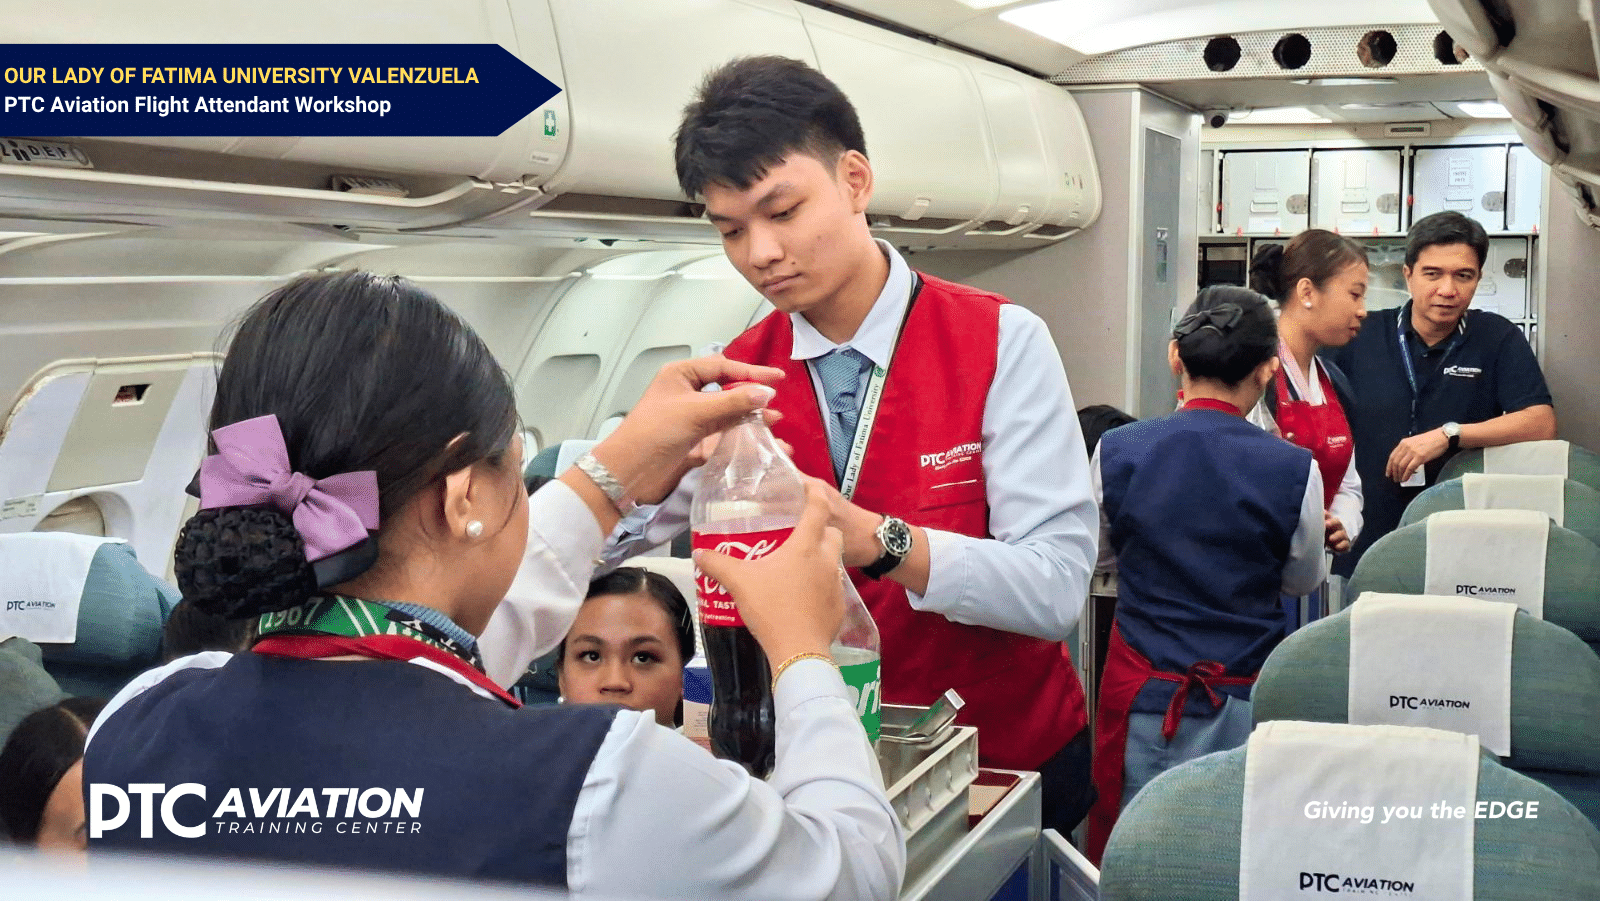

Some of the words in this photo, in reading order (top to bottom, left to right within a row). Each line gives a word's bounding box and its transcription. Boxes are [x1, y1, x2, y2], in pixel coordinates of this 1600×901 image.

[863, 383, 880, 421] University
[855, 424, 869, 450] Fatima
[855, 449, 862, 461] of
[920, 452, 946, 468] PTC
[846, 463, 860, 482] Lady
[1456, 584, 1478, 595] PTC
[1478, 586, 1516, 594] AVIATION
[6, 600, 25, 612] PTC
[1389, 695, 1418, 709] PTC
[1419, 698, 1470, 709] AVIATION
[1299, 872, 1339, 893] PTC
[1341, 877, 1415, 893] AVIATION
